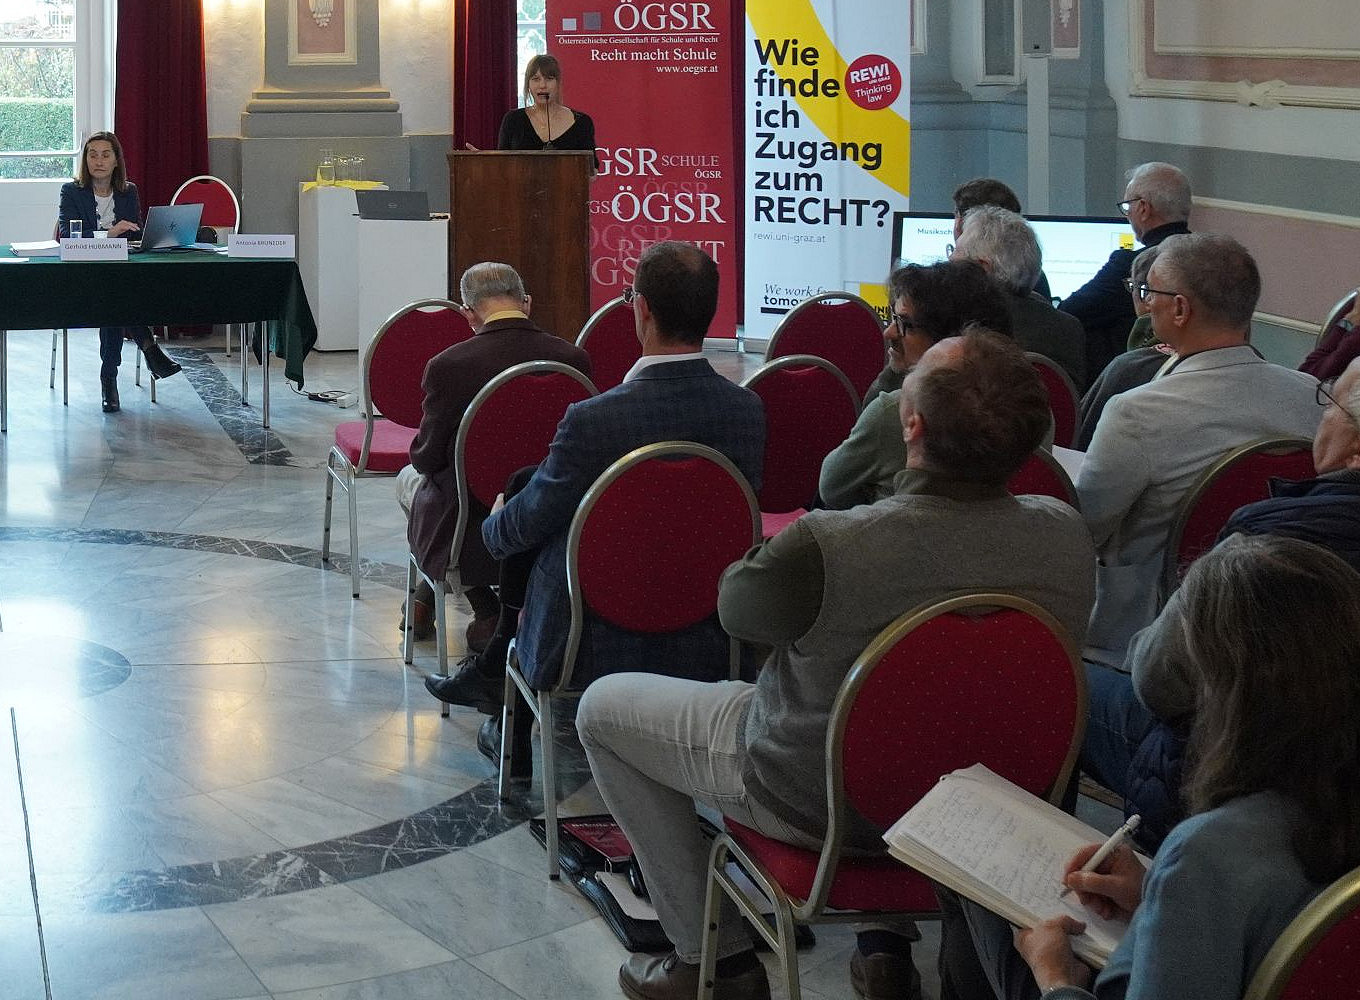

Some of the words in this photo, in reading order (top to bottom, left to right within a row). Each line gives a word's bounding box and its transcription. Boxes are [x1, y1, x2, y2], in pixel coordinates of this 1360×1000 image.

[558, 37, 607, 45] Österreichische
[650, 36, 659, 44] für
[591, 48, 627, 61] Recht
[631, 48, 668, 60] macht
[673, 47, 717, 60] Schule
[754, 38, 819, 67] Wie
[656, 64, 718, 75] www.oegsr.at
[850, 63, 889, 83] REWI
[754, 68, 840, 98] finde
[855, 84, 892, 98] Thinking
[868, 95, 882, 103] law
[755, 101, 800, 129] ich
[755, 132, 883, 171] Zugang
[595, 147, 664, 176] GSR
[661, 155, 720, 167] SCHULE
[694, 168, 722, 179] ÖGSR
[755, 170, 823, 192] zum
[589, 200, 623, 214] GSR
[611, 185, 726, 223] ÖGSR
[754, 196, 890, 228] RECHT?
[754, 231, 826, 244] rewi.uni-graz.at
[765, 283, 782, 294] We
[785, 285, 814, 297] work
[764, 295, 800, 306] tomo
